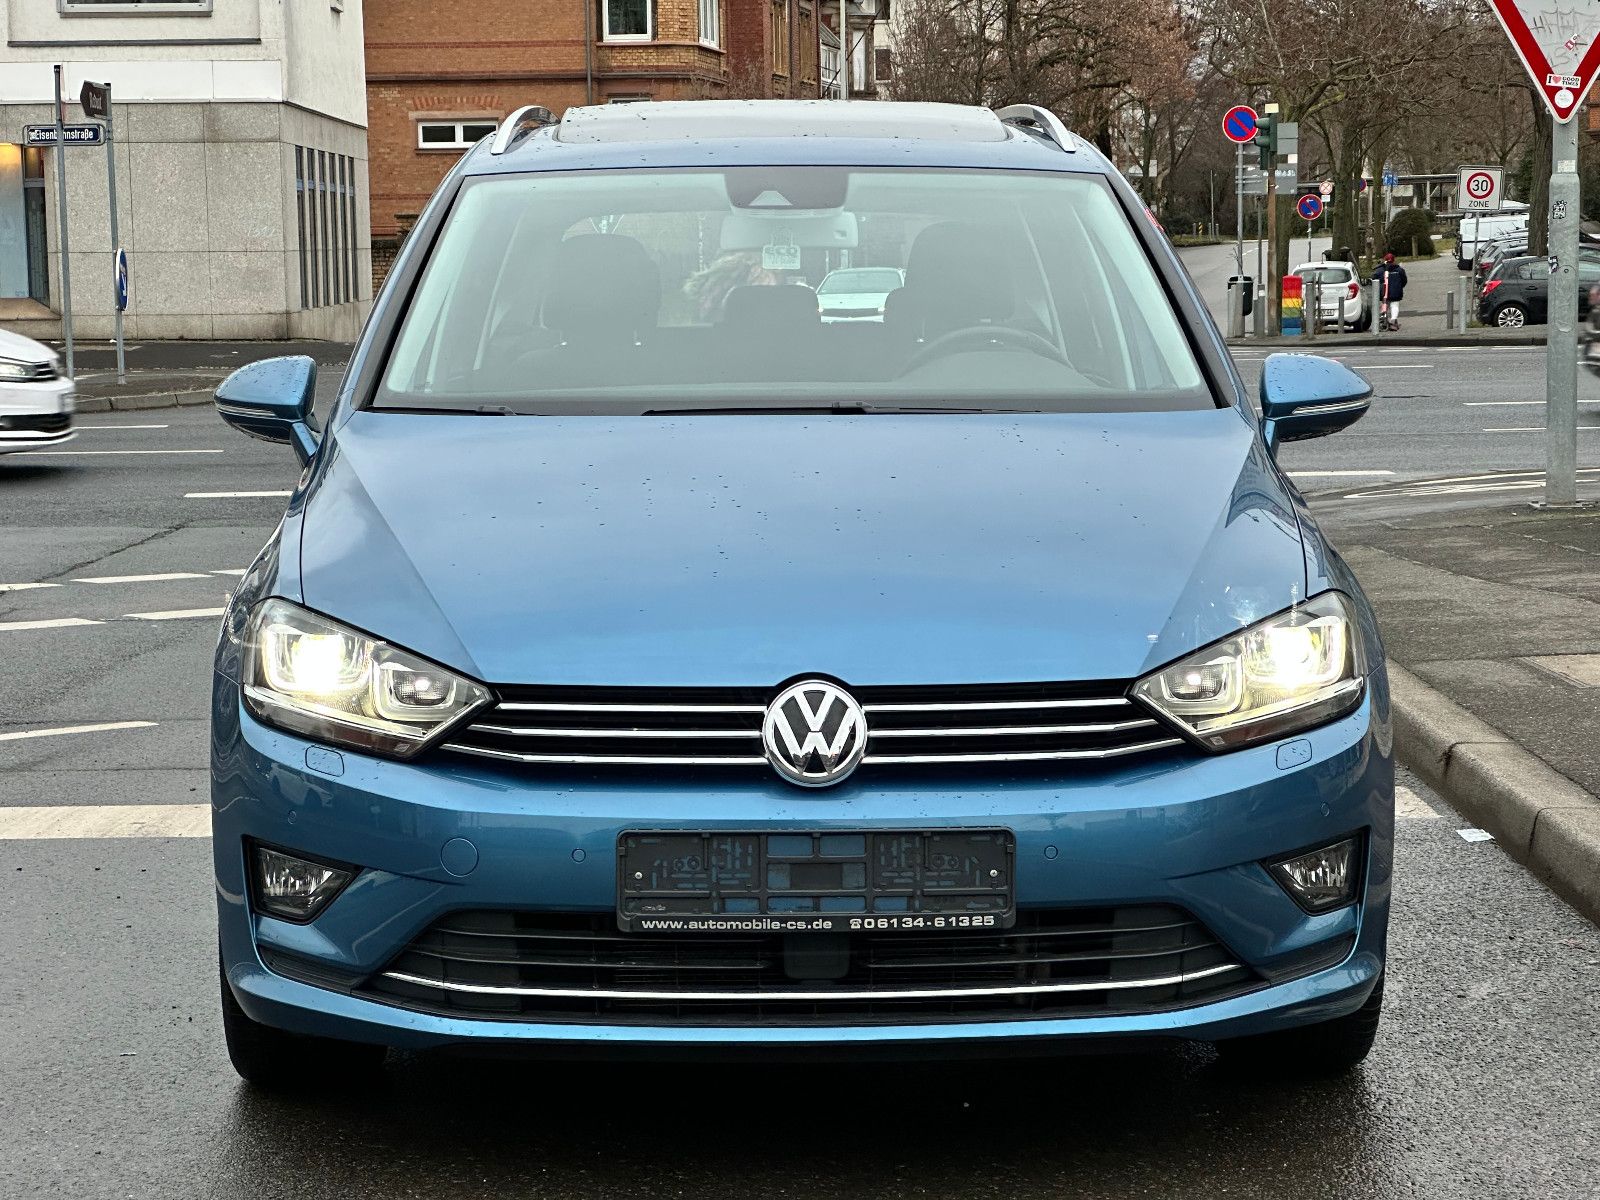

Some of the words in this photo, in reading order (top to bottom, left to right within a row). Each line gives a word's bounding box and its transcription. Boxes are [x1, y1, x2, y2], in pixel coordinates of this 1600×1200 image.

[34, 129, 94, 140] Eisenbhnstraße
[1471, 179, 1489, 192] 30
[1468, 200, 1490, 208] ZONE
[762, 679, 868, 788] VW
[641, 918, 832, 930] www.automobile-cs.de
[863, 915, 996, 930] 06134-61325
